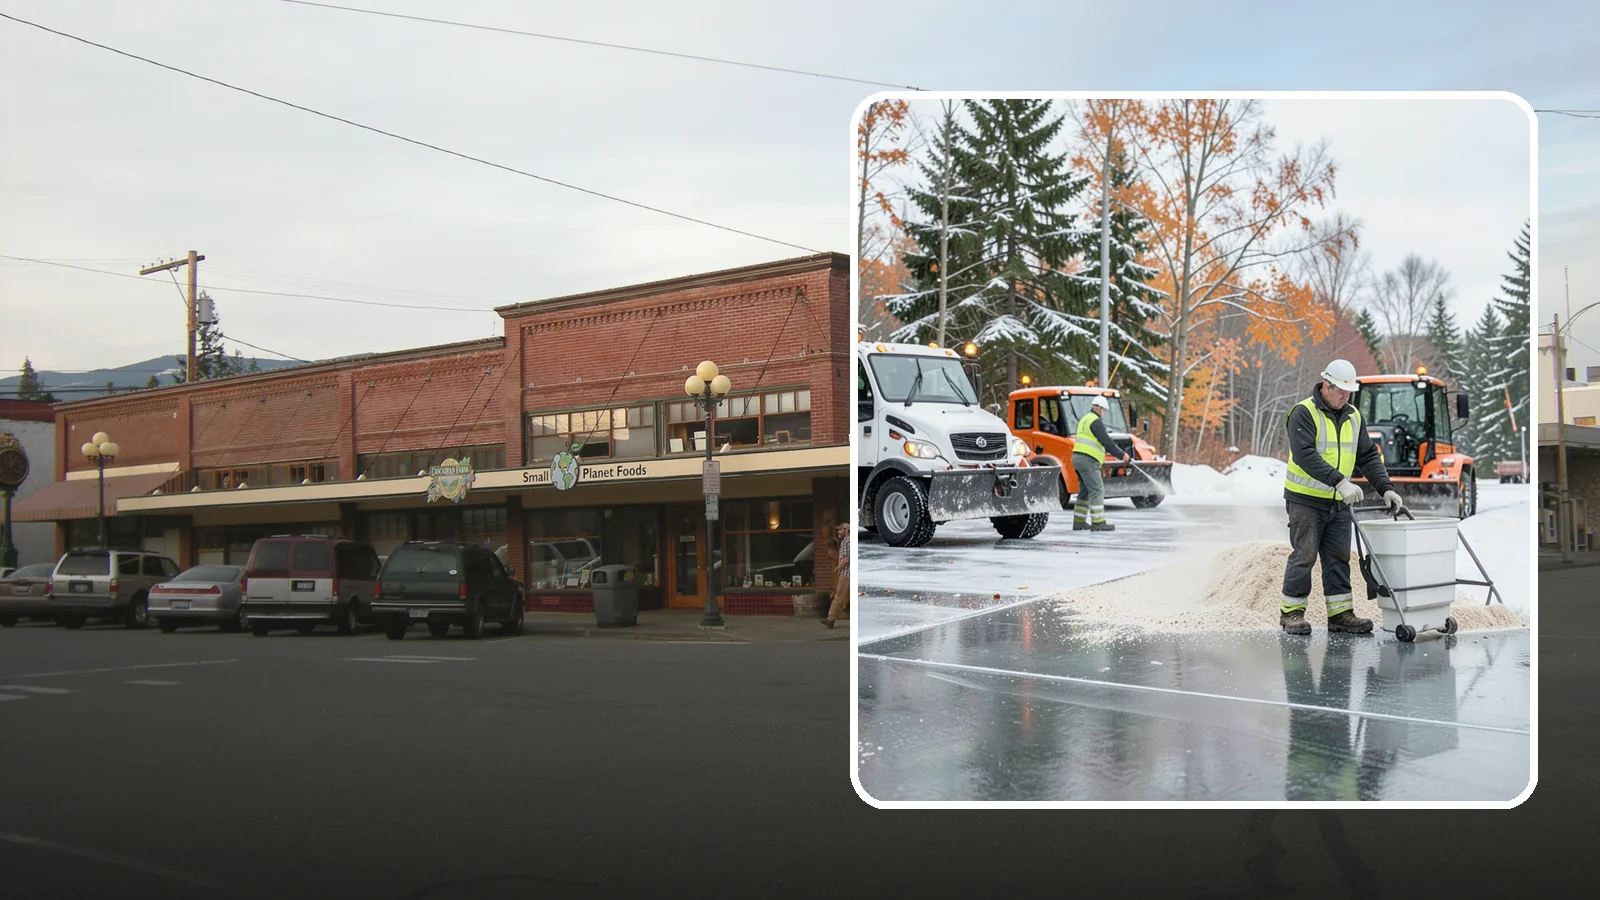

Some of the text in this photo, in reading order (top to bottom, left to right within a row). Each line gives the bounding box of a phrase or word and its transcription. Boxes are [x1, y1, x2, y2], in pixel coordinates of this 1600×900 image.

[523, 464, 647, 483] Small Planet Foods
